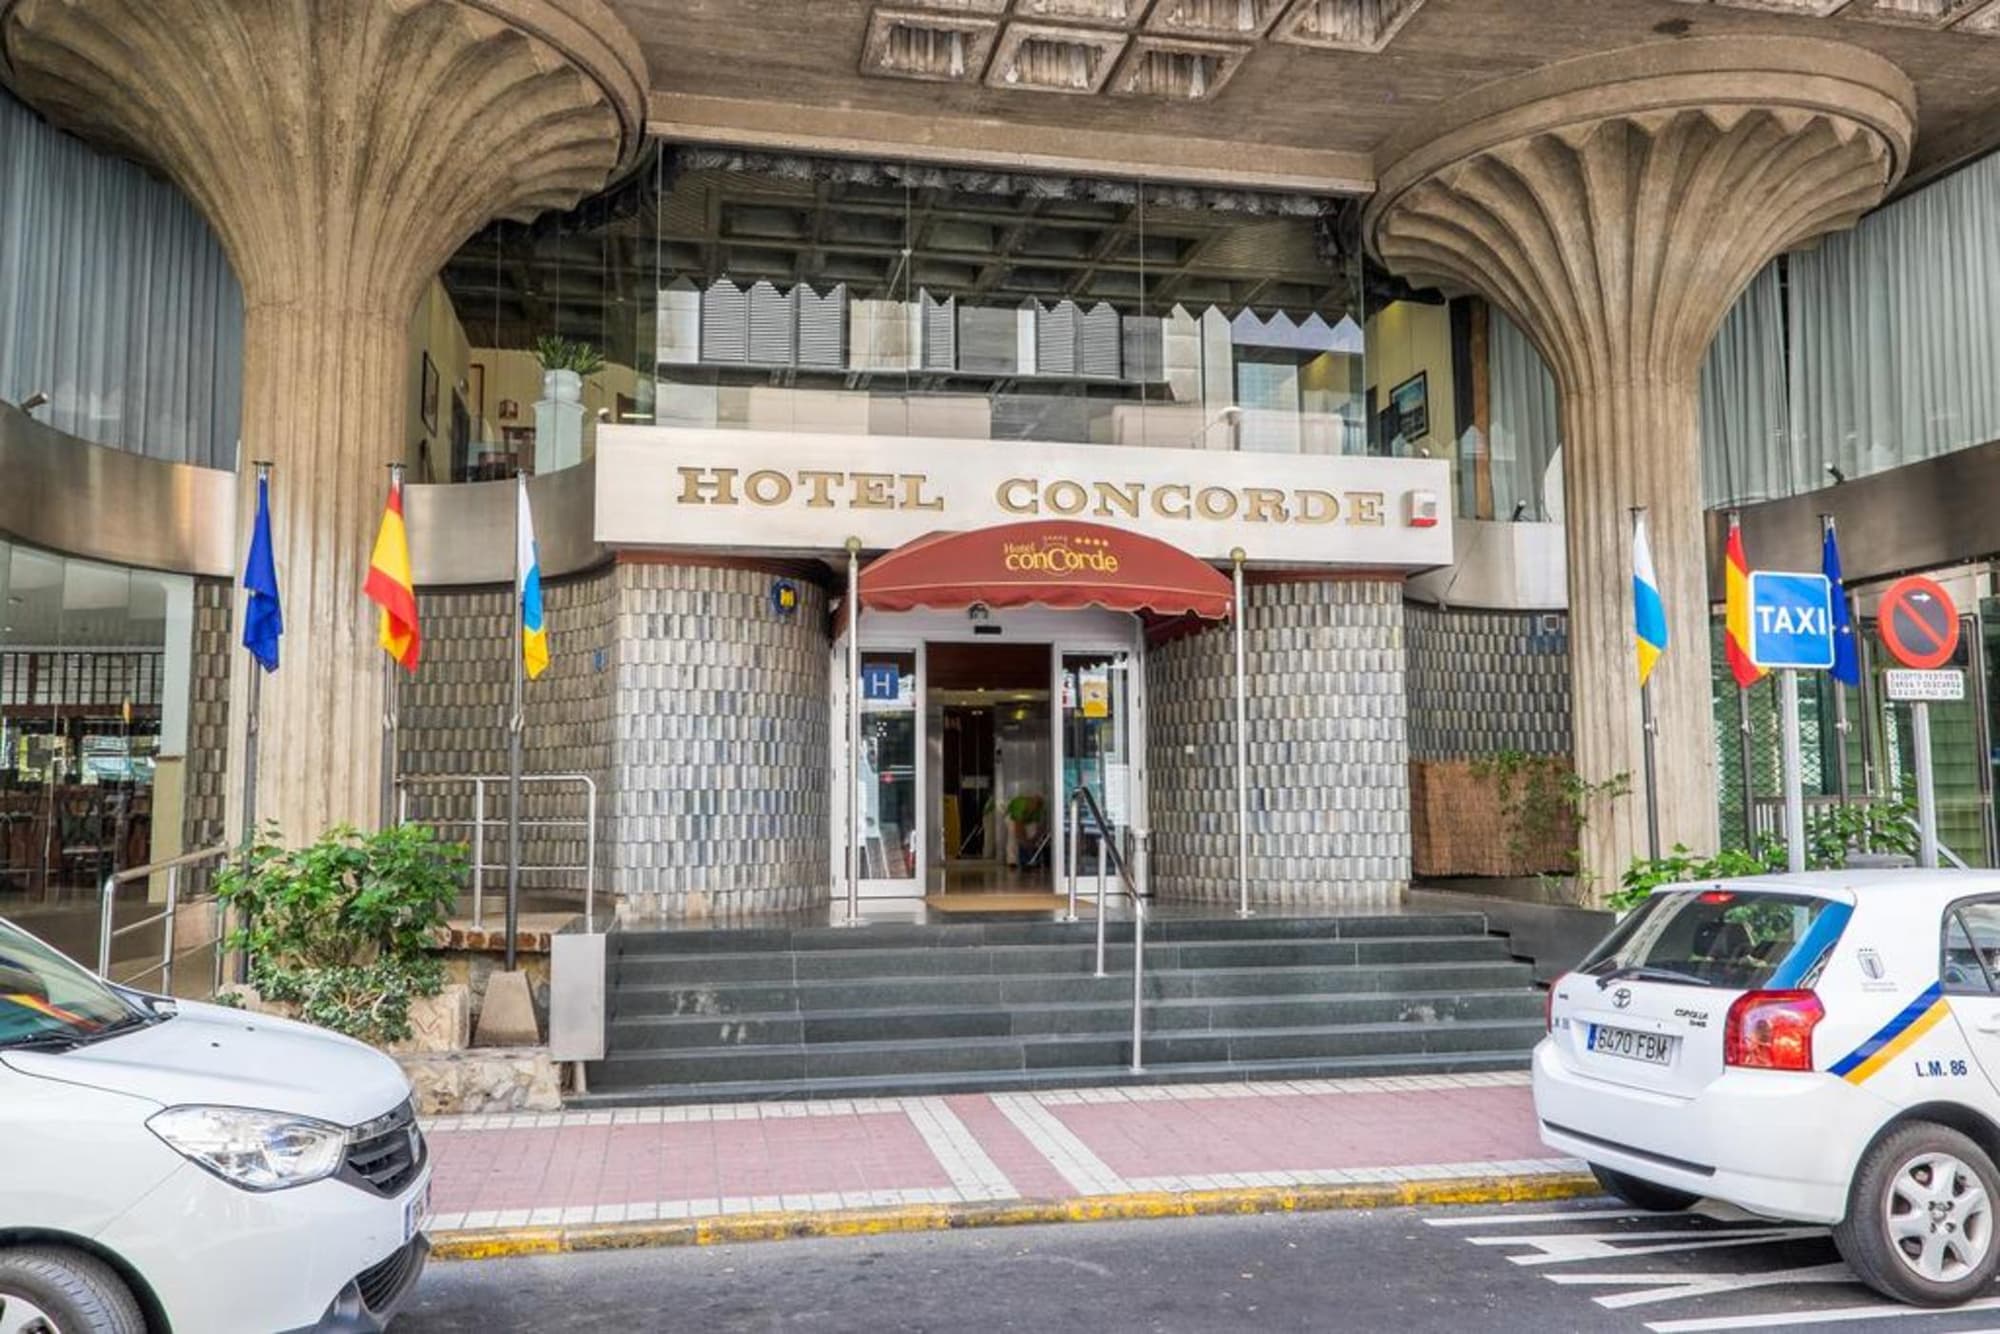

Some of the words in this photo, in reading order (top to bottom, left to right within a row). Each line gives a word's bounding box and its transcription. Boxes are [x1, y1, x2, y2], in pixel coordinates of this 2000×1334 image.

[677, 466, 944, 511] HOTEL
[996, 477, 1385, 528] CONCORDE
[1004, 542, 1036, 554] Hotel
[1756, 605, 1827, 636] TAXI
[872, 672, 890, 697] H
[1597, 1028, 1633, 1055] 6470
[1915, 1060, 1948, 1077] L.M.
[1950, 1059, 1967, 1076] 86
